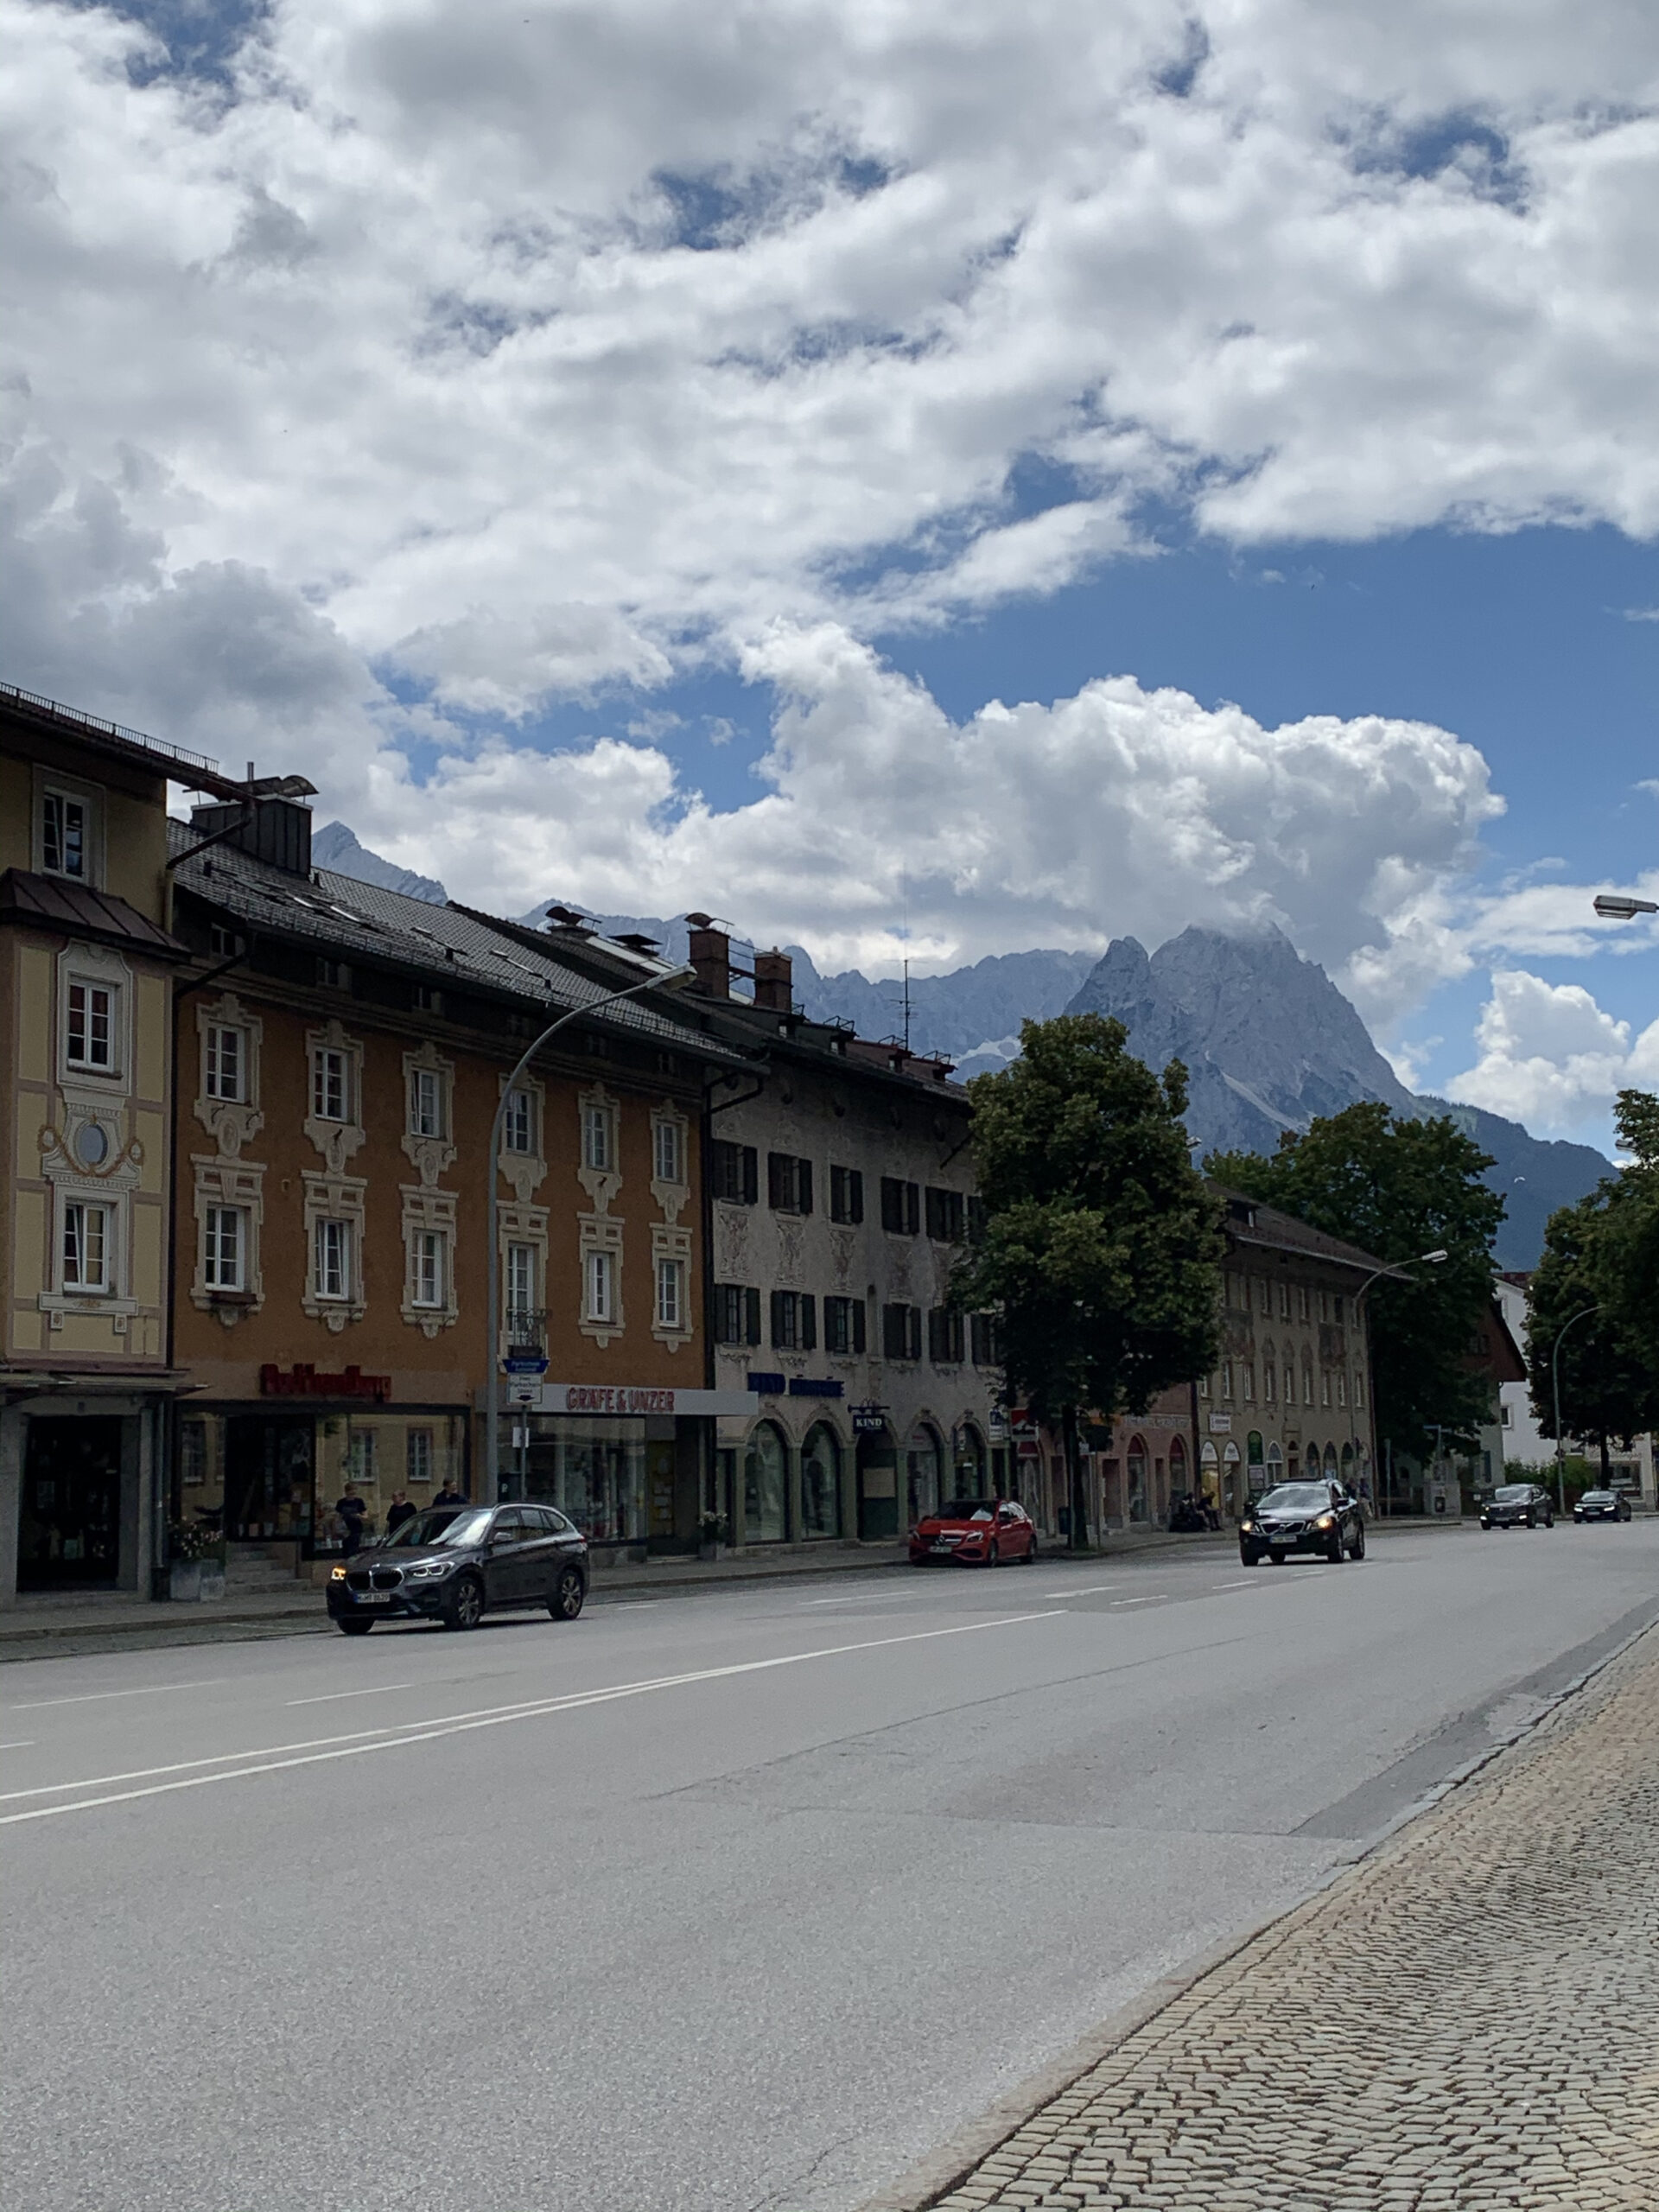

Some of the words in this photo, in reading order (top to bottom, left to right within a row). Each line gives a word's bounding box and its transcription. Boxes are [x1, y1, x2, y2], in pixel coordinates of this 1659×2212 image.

[617, 1389, 626, 1411] &
[628, 1389, 675, 1412] UNZER
[855, 1418, 882, 1427] KIND
